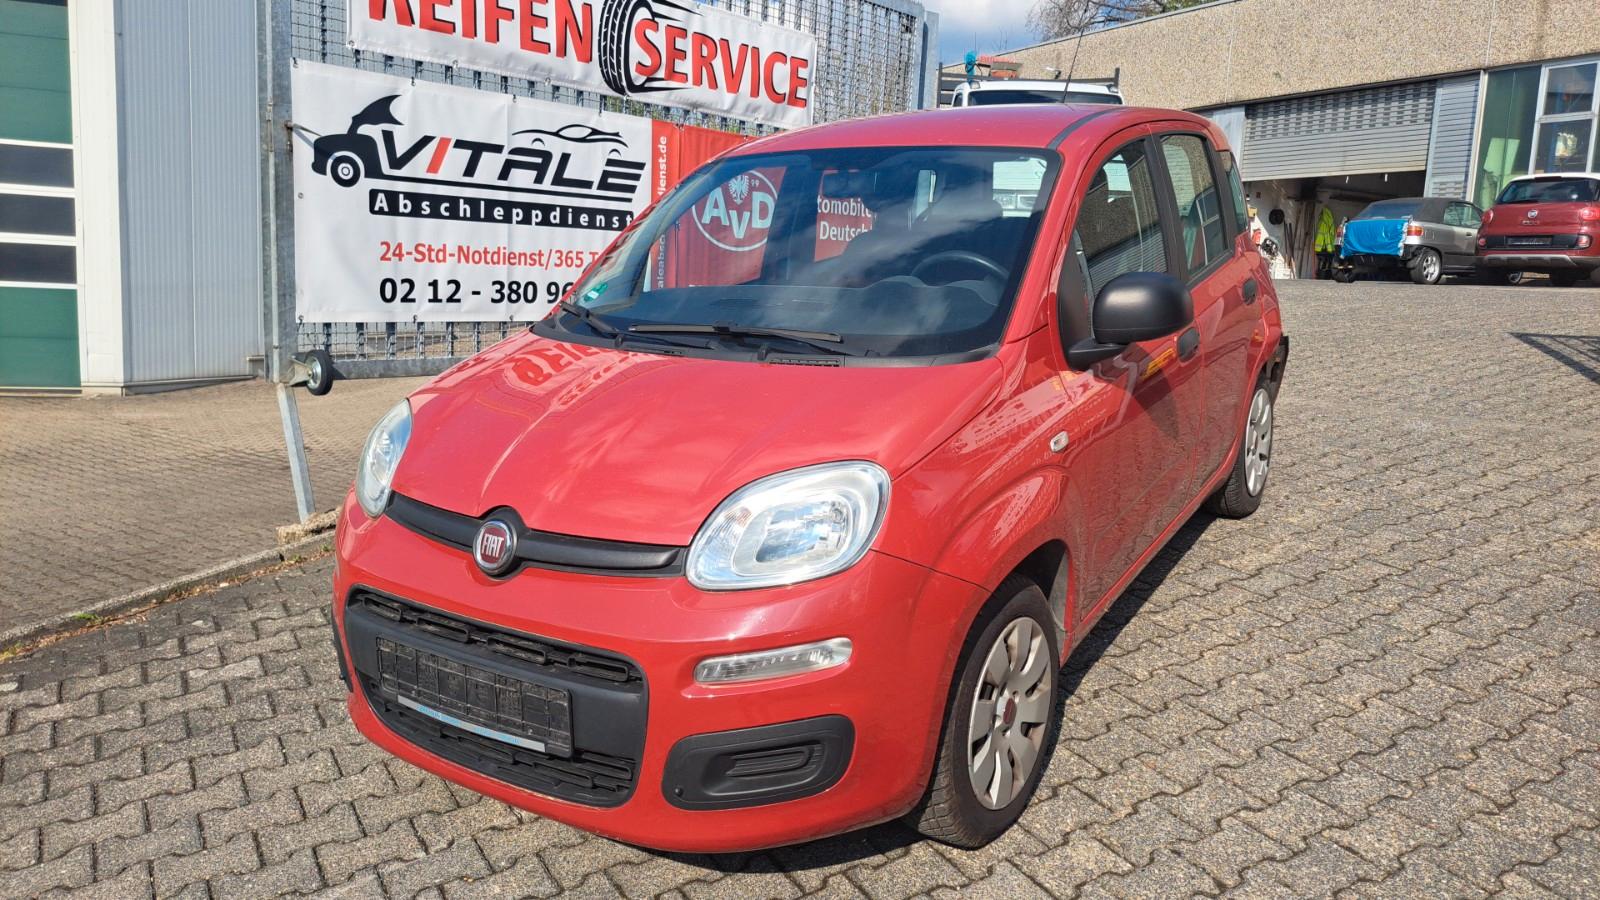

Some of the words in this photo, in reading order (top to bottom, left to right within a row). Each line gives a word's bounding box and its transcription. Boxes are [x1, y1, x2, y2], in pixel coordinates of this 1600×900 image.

[634, 18, 809, 108] SERVICE
[381, 129, 646, 194] VITALE
[374, 192, 632, 228] Abschleppdienst
[379, 241, 584, 270] 24-Std-Notdienst/365
[379, 278, 416, 303] 02
[428, 279, 462, 304] 12
[490, 280, 538, 304] 380
[481, 533, 505, 558] FIAT
